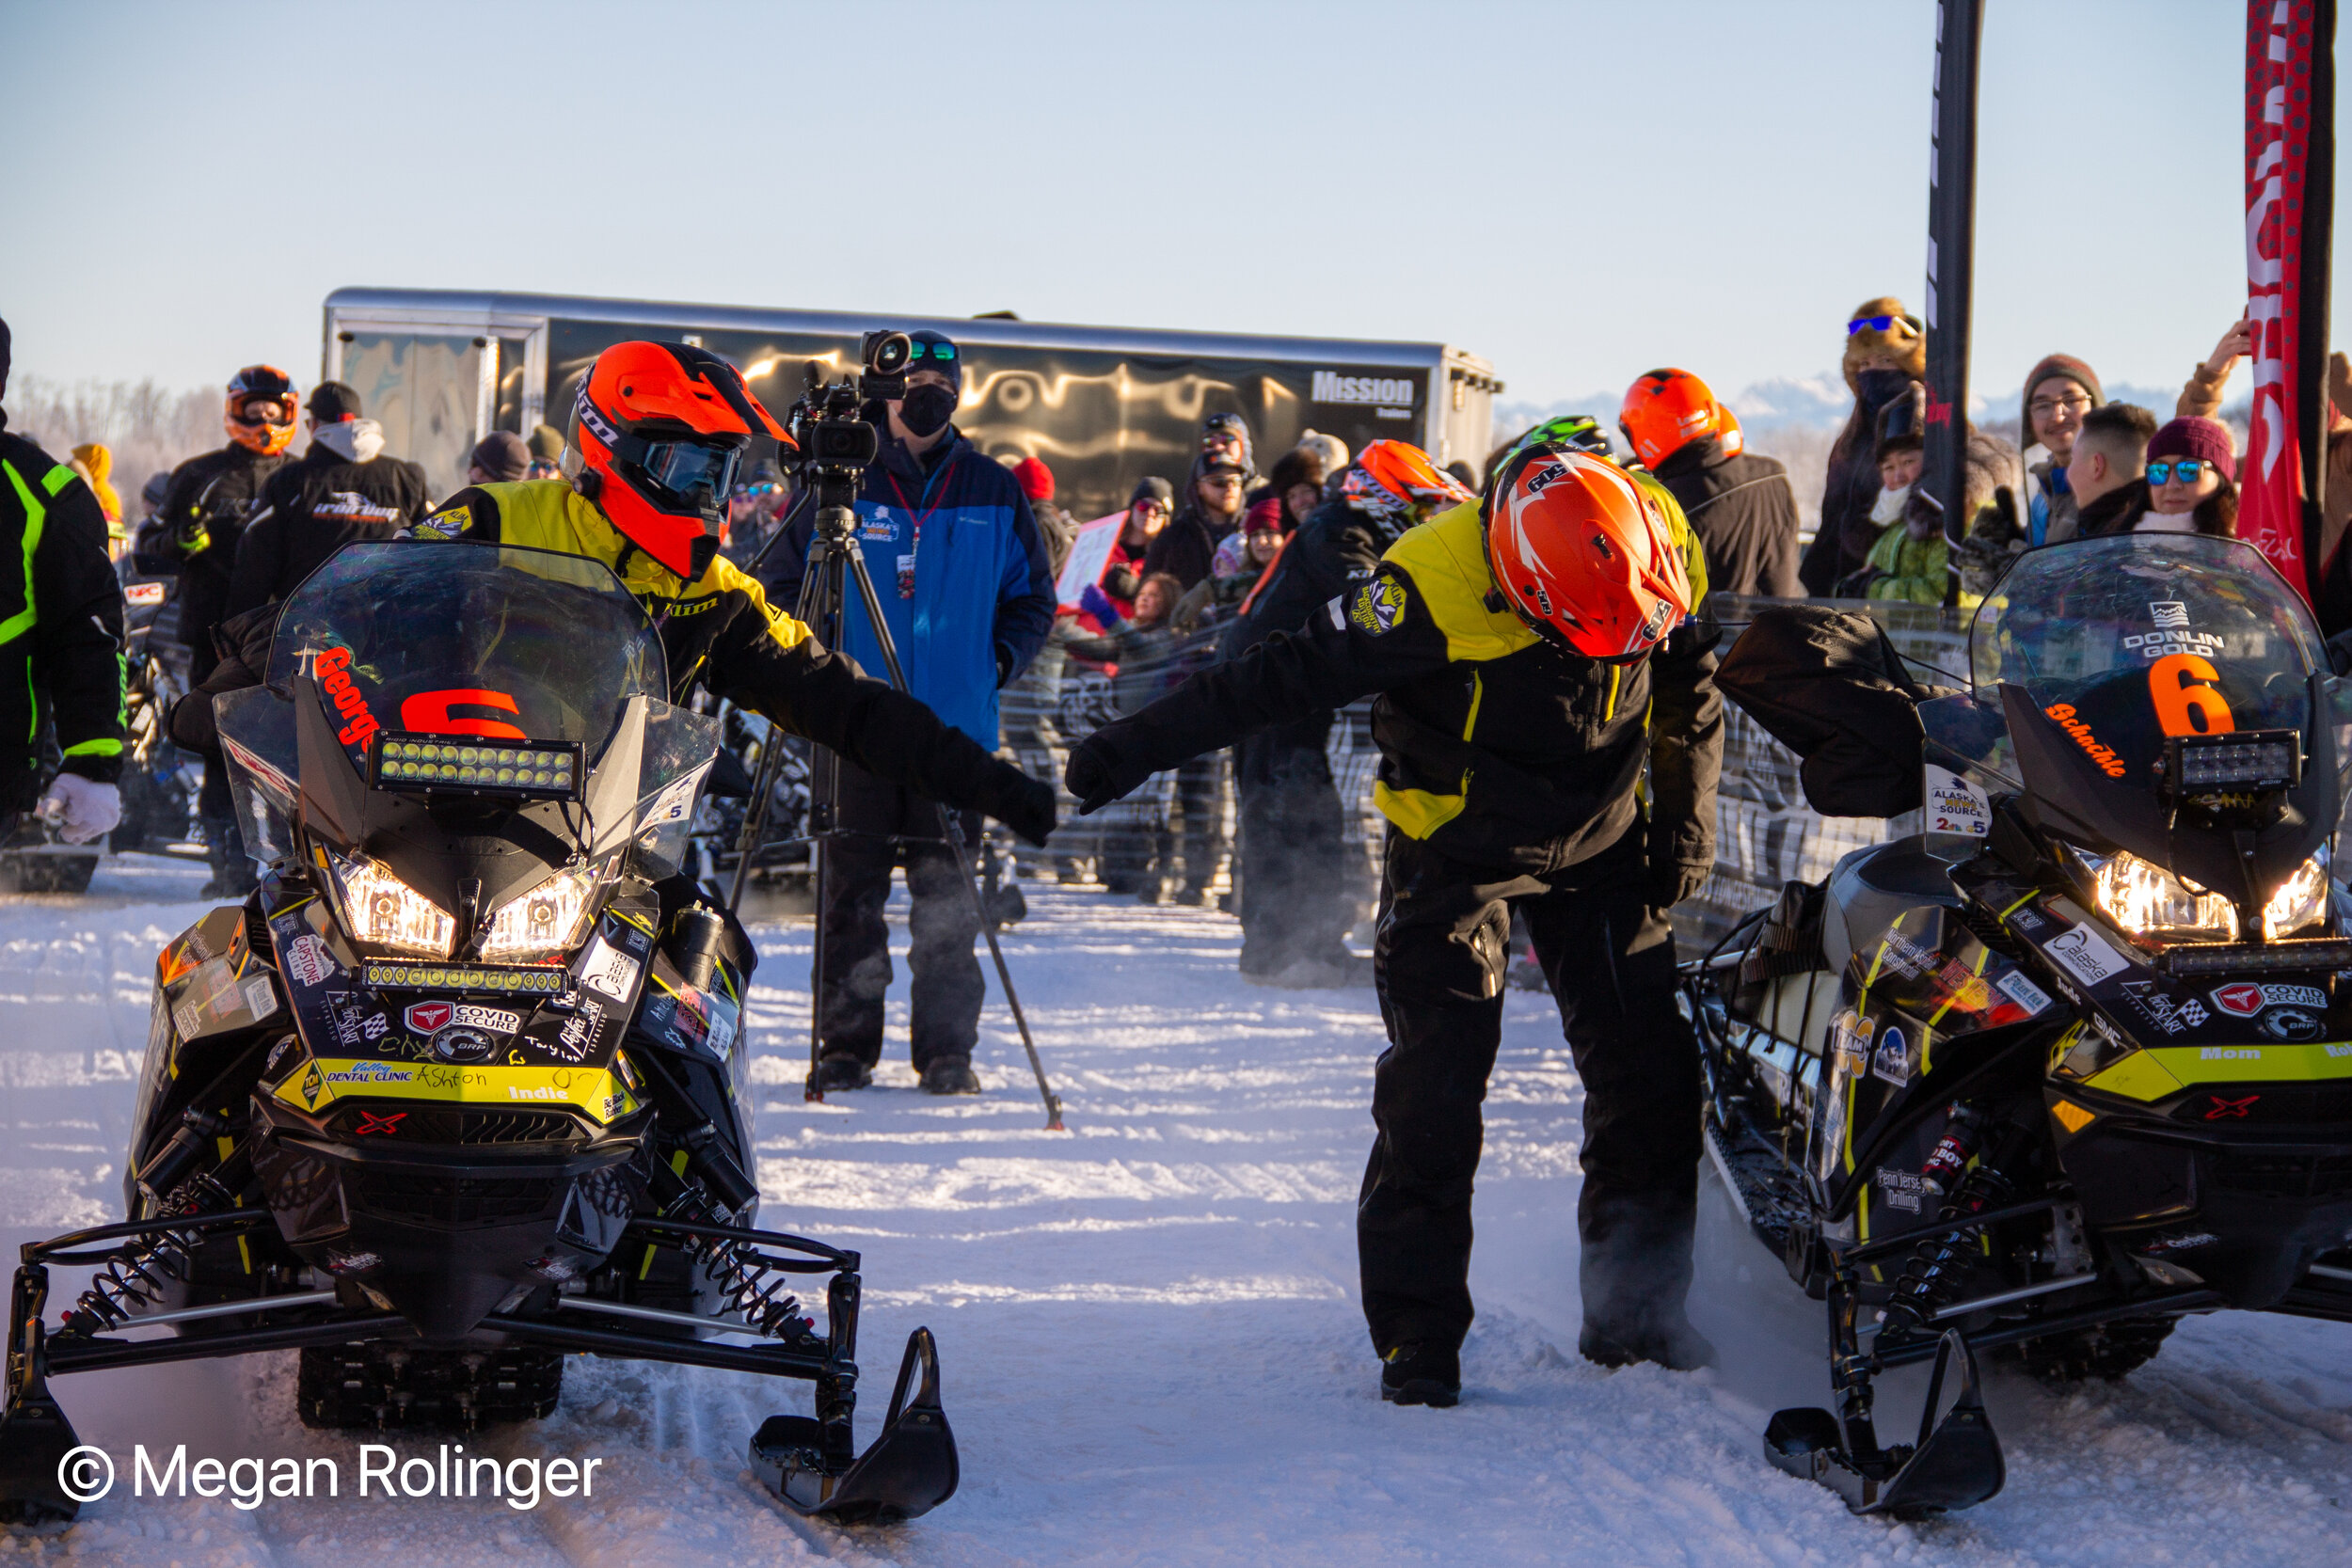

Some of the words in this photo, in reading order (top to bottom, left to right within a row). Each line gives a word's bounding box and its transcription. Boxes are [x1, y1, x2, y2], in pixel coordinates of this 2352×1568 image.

[1311, 371, 1413, 404] Mission
[1528, 464, 1568, 493] 509
[1358, 598, 1373, 629] EDITION
[1361, 586, 1382, 633] BACKCOUNTRY
[1536, 590, 1552, 616] 509
[2123, 631, 2225, 649] DONLIN
[2143, 643, 2215, 658] GOLD
[2149, 654, 2235, 736] 6
[2044, 703, 2126, 778] Schachle
[670, 805, 682, 818] 5
[1939, 805, 1983, 817] SOURCE
[1936, 816, 1949, 831] 2
[1974, 820, 1987, 834] 5
[1885, 927, 1915, 955] Northern
[289, 950, 303, 979] CLINIC
[294, 937, 321, 985] CAPSTONE
[1883, 947, 1921, 980] Construction
[2068, 945, 2107, 980] alaska
[1940, 958, 2007, 1015] WESTERN
[2057, 976, 2081, 1005] Jude
[2264, 985, 2324, 998] COVID
[2266, 993, 2326, 1006] SECURE
[454, 1016, 516, 1032] SECURE
[455, 1006, 516, 1023] COVID
[589, 1013, 608, 1053] ESPRESSO
[2093, 1012, 2122, 1048] GMC
[2288, 1022, 2314, 1030] BRP
[457, 1042, 486, 1051] BRP
[2200, 1047, 2262, 1060] Mom
[326, 1072, 371, 1082] DENTAL
[373, 1071, 413, 1082] CLINIC
[351, 1062, 391, 1073] Valley
[508, 1086, 568, 1100] Indie
[1938, 1148, 1963, 1167] BOY
[1878, 1168, 1899, 1186] Penn
[1888, 1189, 1919, 1213] Drilling
